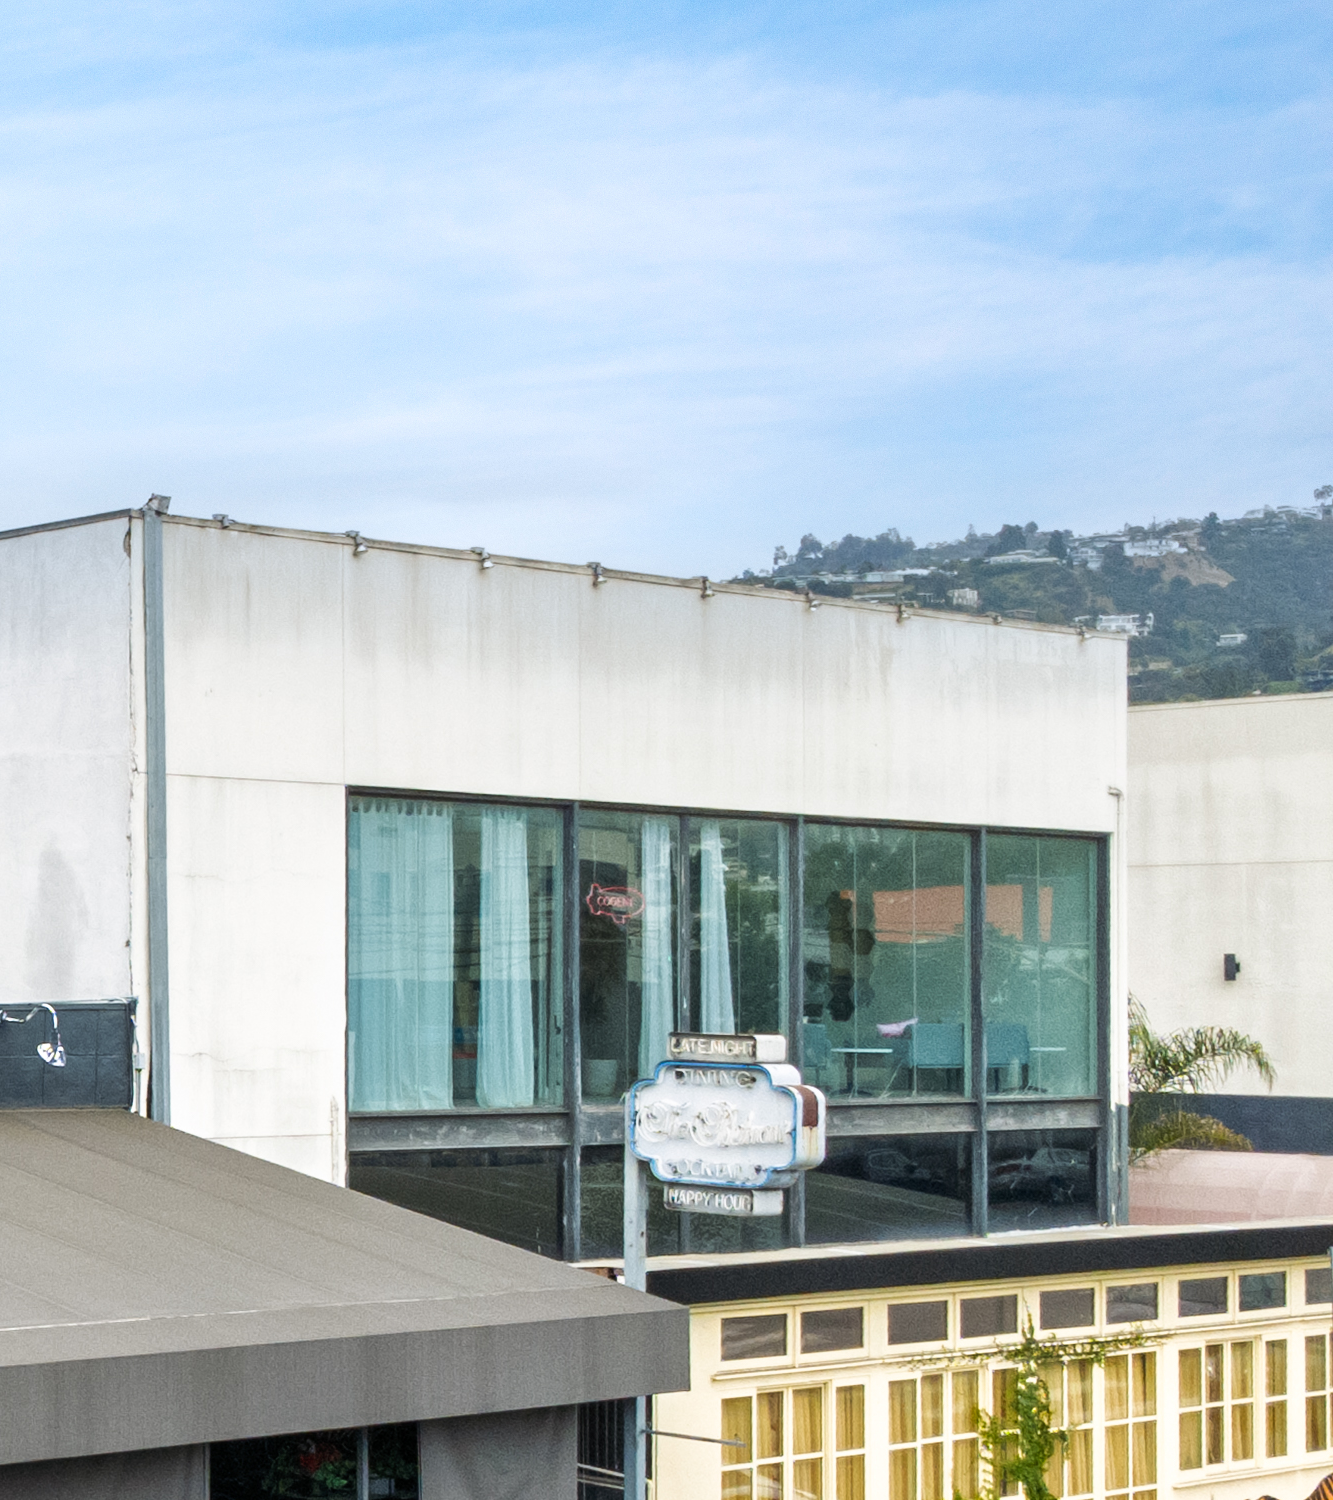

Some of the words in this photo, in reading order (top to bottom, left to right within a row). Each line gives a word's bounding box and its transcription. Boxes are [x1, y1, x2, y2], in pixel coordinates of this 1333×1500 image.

[671, 1038, 709, 1054] LATE
[710, 1040, 754, 1057] NIGHT
[669, 1188, 712, 1205] HAPPY
[715, 1194, 752, 1211] HOUR
